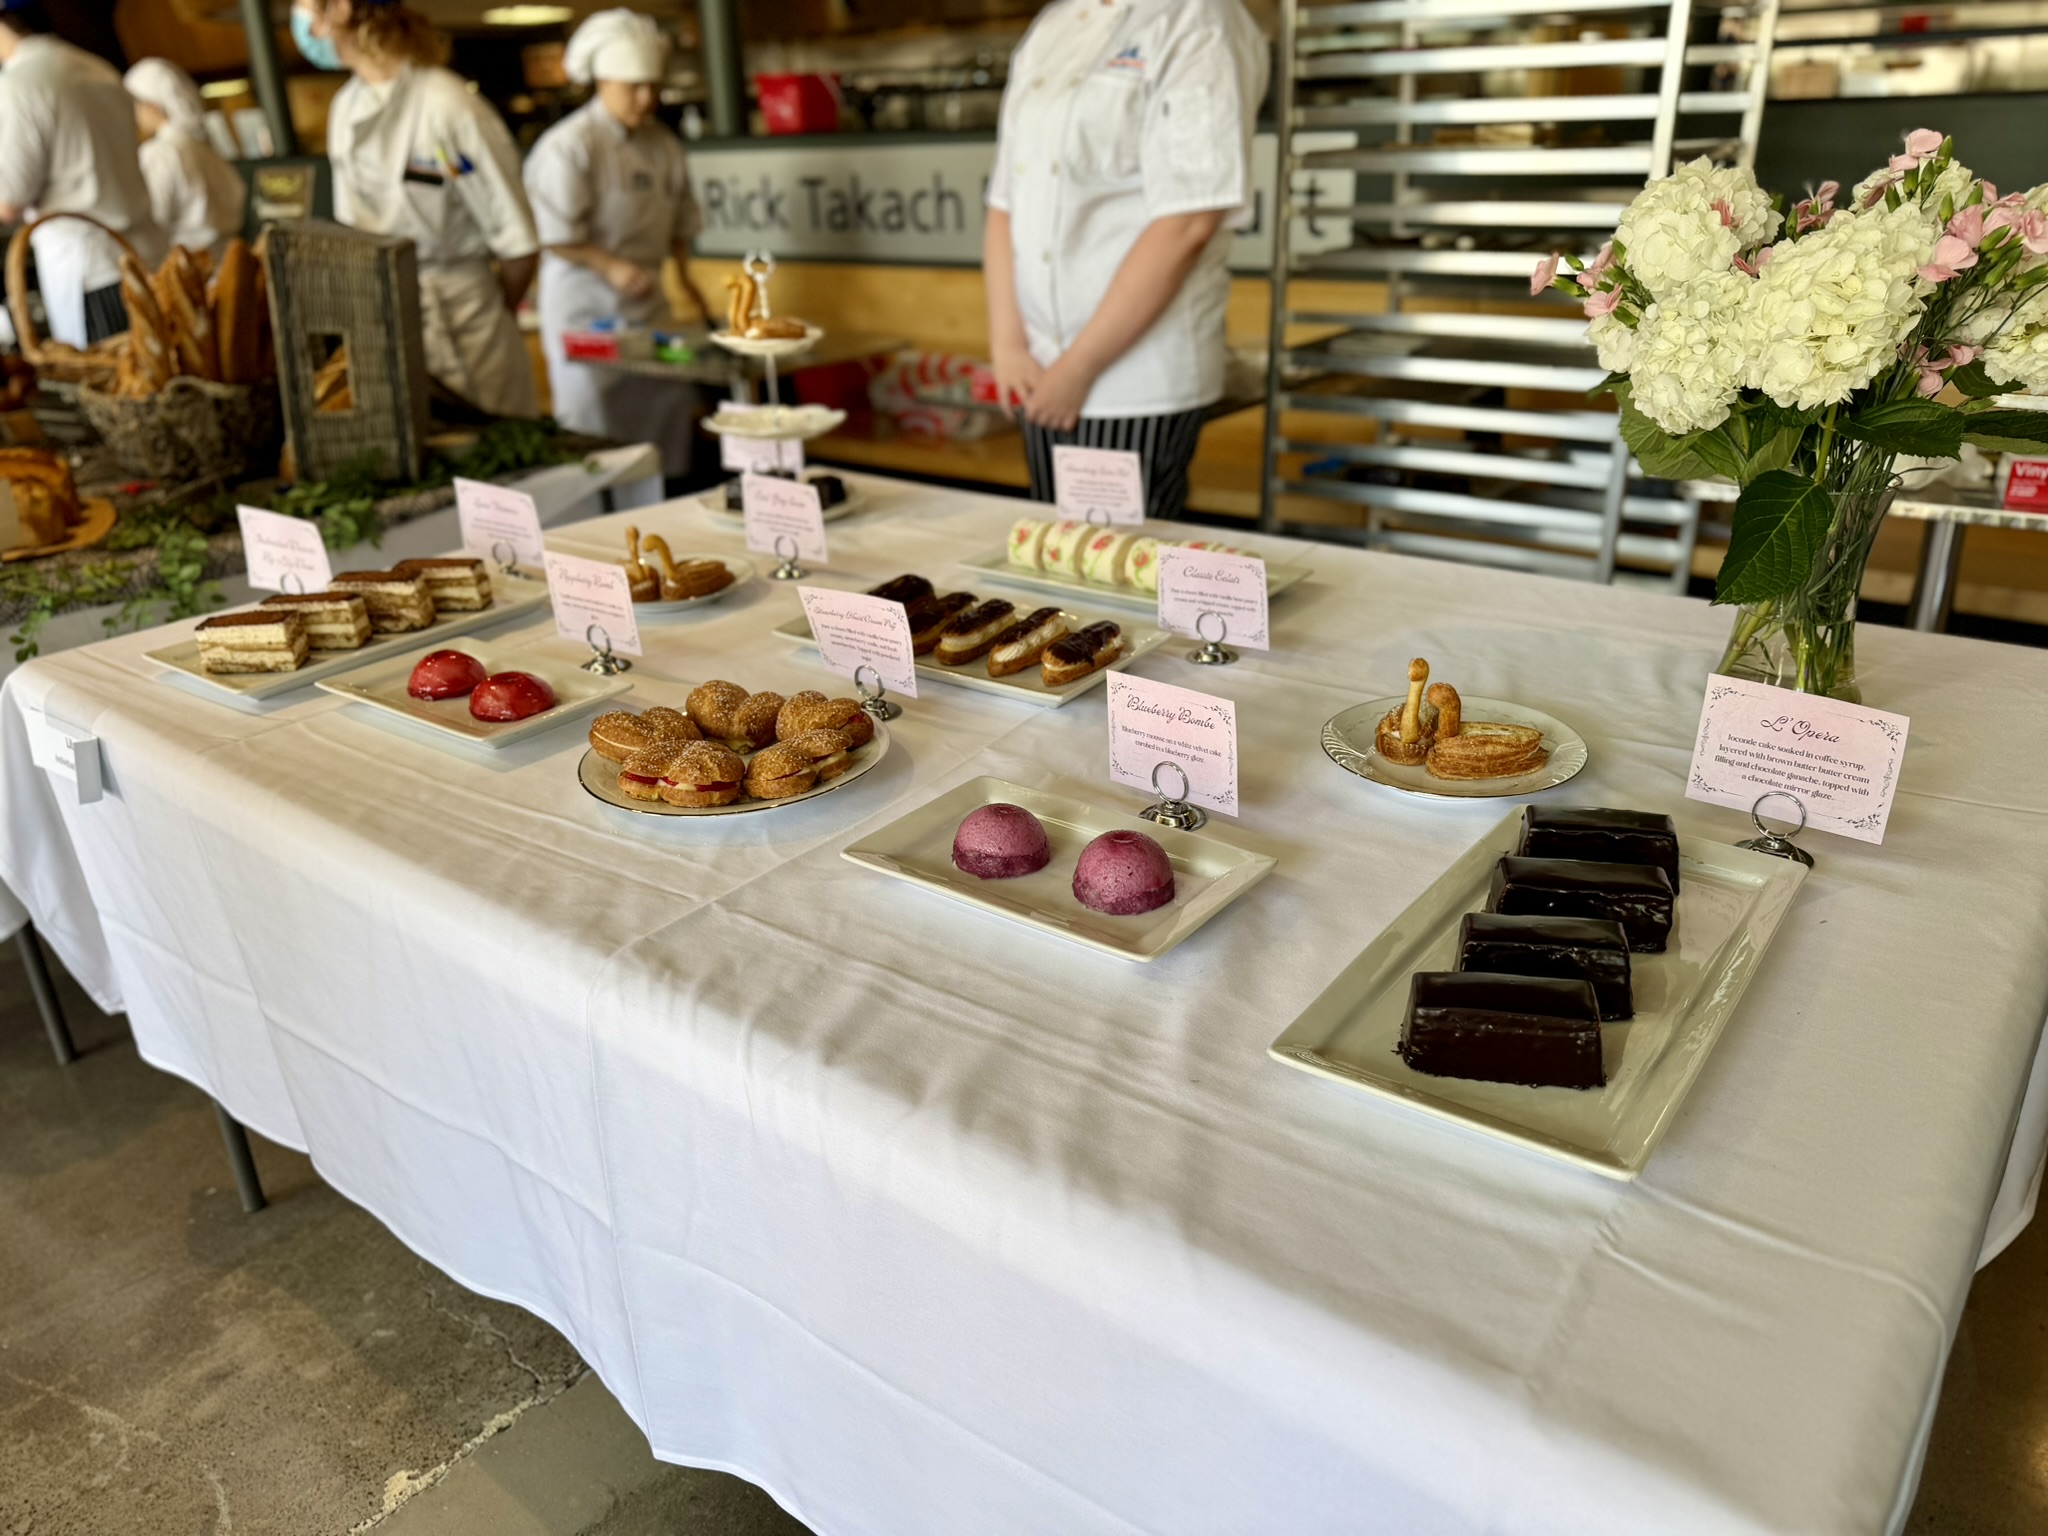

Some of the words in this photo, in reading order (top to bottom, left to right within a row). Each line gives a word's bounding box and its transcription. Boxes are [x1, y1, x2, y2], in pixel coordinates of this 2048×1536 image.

[702, 176, 788, 230] Rick
[799, 172, 966, 232] Takach
[1183, 565, 1213, 581] Classic
[1126, 694, 1176, 724] Blueberry
[1178, 706, 1215, 730] Bombe
[1121, 725, 1146, 739] Blueberry
[1146, 733, 1166, 743] mousse
[1177, 741, 1192, 750] white
[1192, 745, 1209, 754] velvet
[1209, 749, 1222, 758] cake
[1134, 740, 1156, 750] enrobed
[1155, 744, 1161, 752] in
[1164, 747, 1190, 761] blueberry
[1727, 733, 1758, 747] Joconde
[1758, 742, 1777, 751] cake
[1777, 746, 1805, 757] soaked
[1805, 750, 1814, 759] in
[1814, 754, 1839, 765] coffee
[1714, 754, 1736, 767] filling
[1735, 761, 1750, 769] and
[1750, 763, 1787, 777] chocolate
[1822, 780, 1850, 792] topped
[1851, 787, 1870, 797] with
[1719, 743, 1748, 756] layered
[1748, 751, 1766, 761] with
[1766, 754, 1793, 767] brown
[1793, 760, 1818, 772] butter
[1818, 766, 1843, 778] butter
[1843, 773, 1870, 784] cream
[1747, 774, 1783, 789] chocolate
[1783, 784, 1811, 795] mirror
